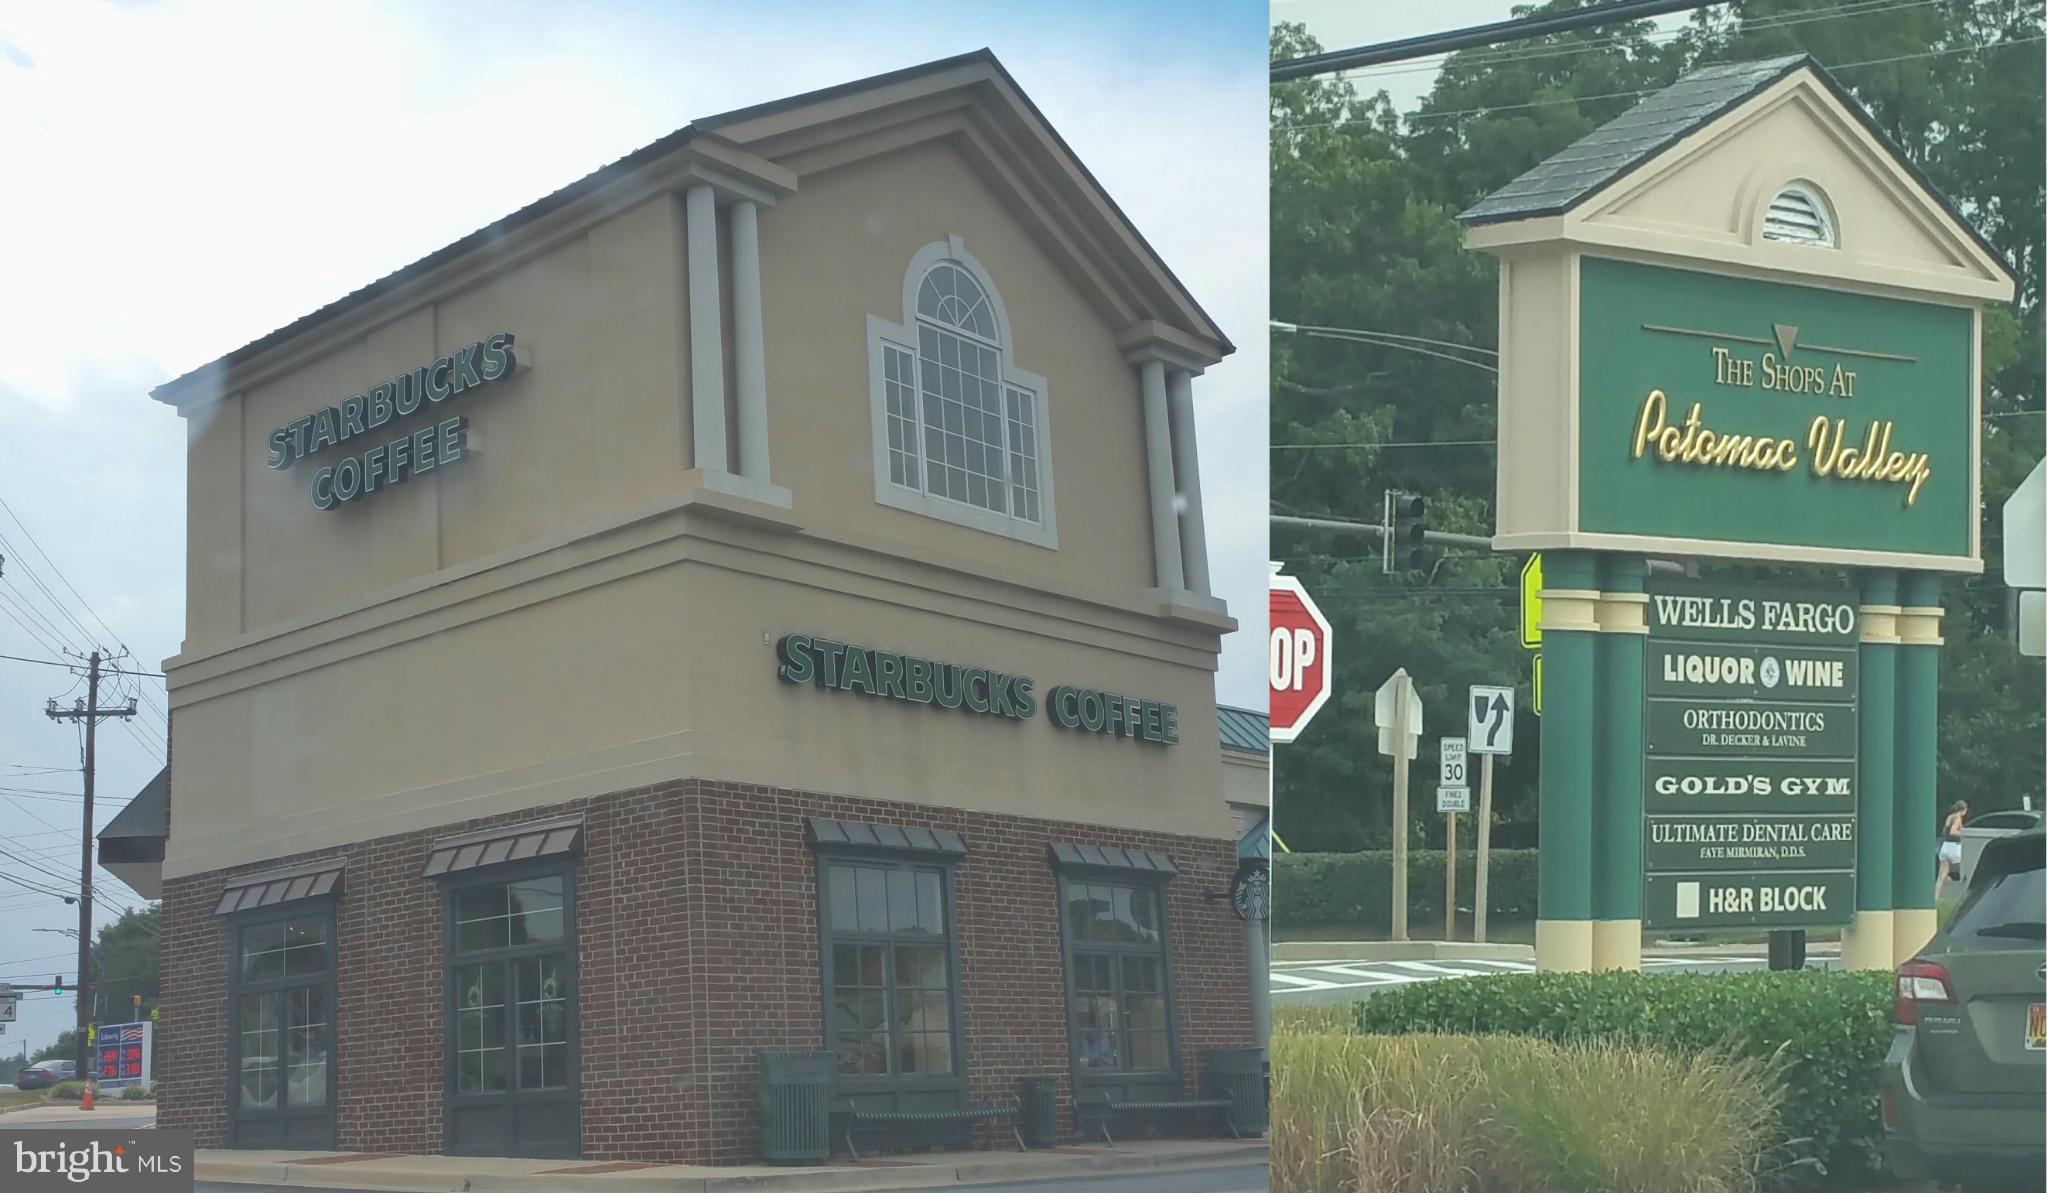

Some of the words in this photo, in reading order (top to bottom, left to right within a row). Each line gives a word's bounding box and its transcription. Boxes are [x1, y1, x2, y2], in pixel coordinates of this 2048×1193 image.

[266, 332, 517, 471] STARBUCKS
[1632, 389, 1797, 472] Potomac
[1808, 415, 1931, 505] Valley
[310, 415, 469, 511] COFFEE
[1654, 595, 1756, 630] WELLS
[1761, 601, 1855, 634] FARGO
[1664, 654, 1755, 684] LIQUOR
[1785, 659, 1844, 688] WINE
[778, 633, 1038, 722] STARBUCKS
[1048, 684, 1180, 746] COFFEE
[1683, 708, 1825, 732] ORTHODONTICS
[1702, 734, 1718, 746] DR.
[1720, 734, 1760, 747] DECKER
[1772, 735, 1807, 747] LAVINE
[1444, 763, 1463, 781] 30
[1655, 774, 1772, 795] GOLD'S
[1780, 777, 1851, 795] GYM
[1652, 824, 1739, 843] ULTIMATE
[1742, 823, 1808, 842] DENTAL
[1810, 823, 1853, 841] CARE
[1700, 847, 1724, 859] FAYE
[1709, 887, 1754, 913] H&R
[1759, 886, 1827, 911] BLOCK
